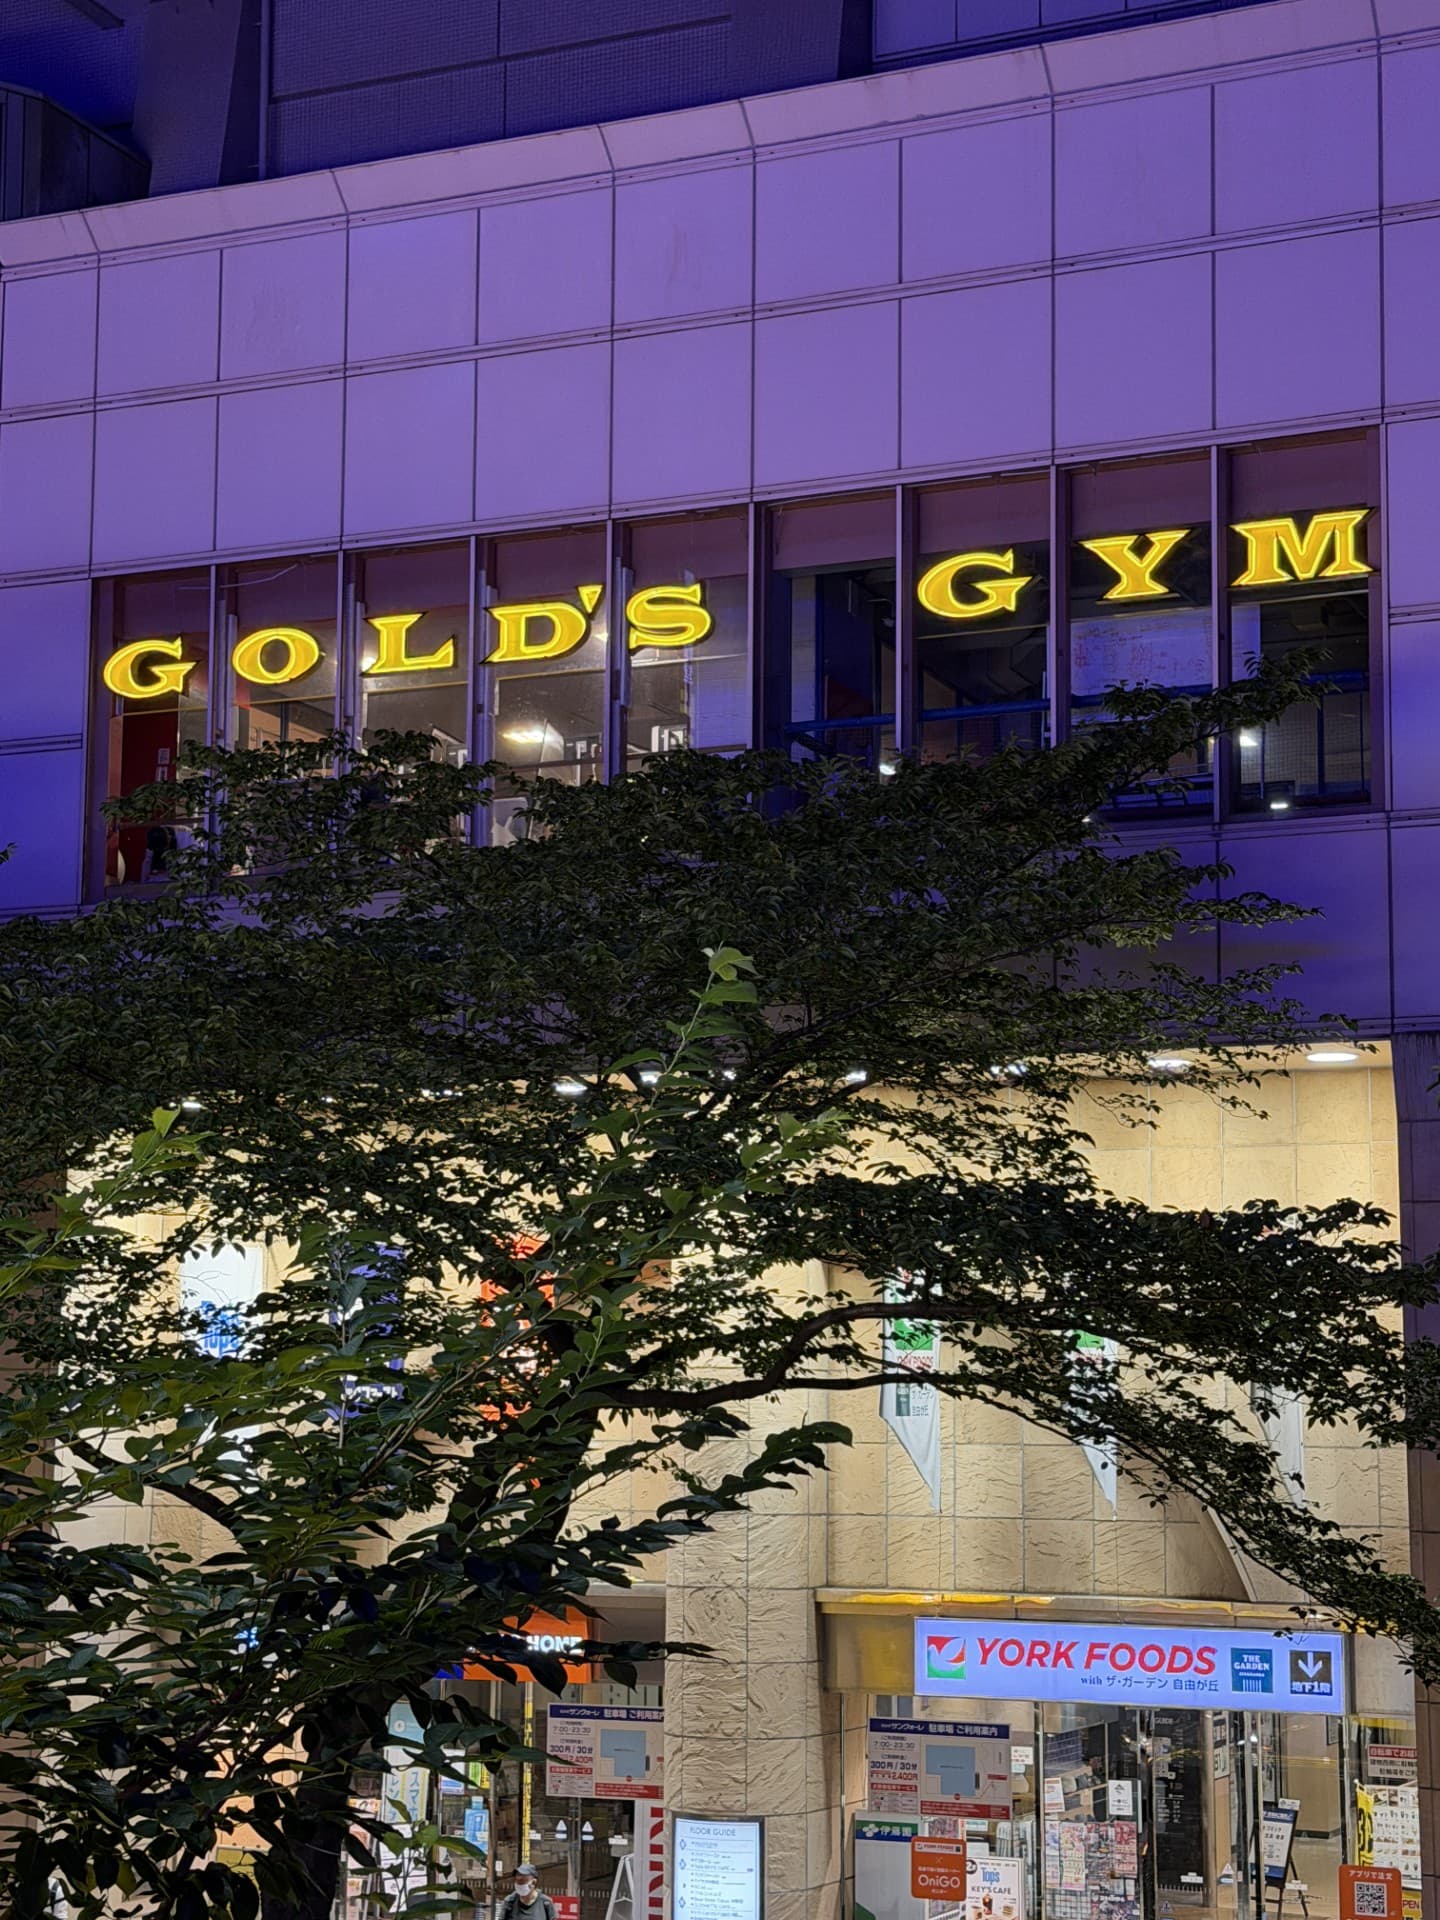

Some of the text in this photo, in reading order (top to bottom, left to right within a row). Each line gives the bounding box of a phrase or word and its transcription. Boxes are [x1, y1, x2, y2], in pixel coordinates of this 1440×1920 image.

[102, 507, 1375, 700] GOLD'S GYM
[976, 1637, 1218, 1676] YORK FOODS
[1242, 1654, 1260, 1663] THE
[1233, 1662, 1271, 1671] GARDEN
[1080, 1675, 1220, 1692] with ザ・ガーデン 自由が丘
[712, 1828, 736, 1836] GUIDE
[917, 1873, 961, 1889] OniGO
[980, 1867, 1001, 1886] Tops
[992, 1887, 1012, 1896] CAFE
[1402, 1900, 1420, 1910] PEN
